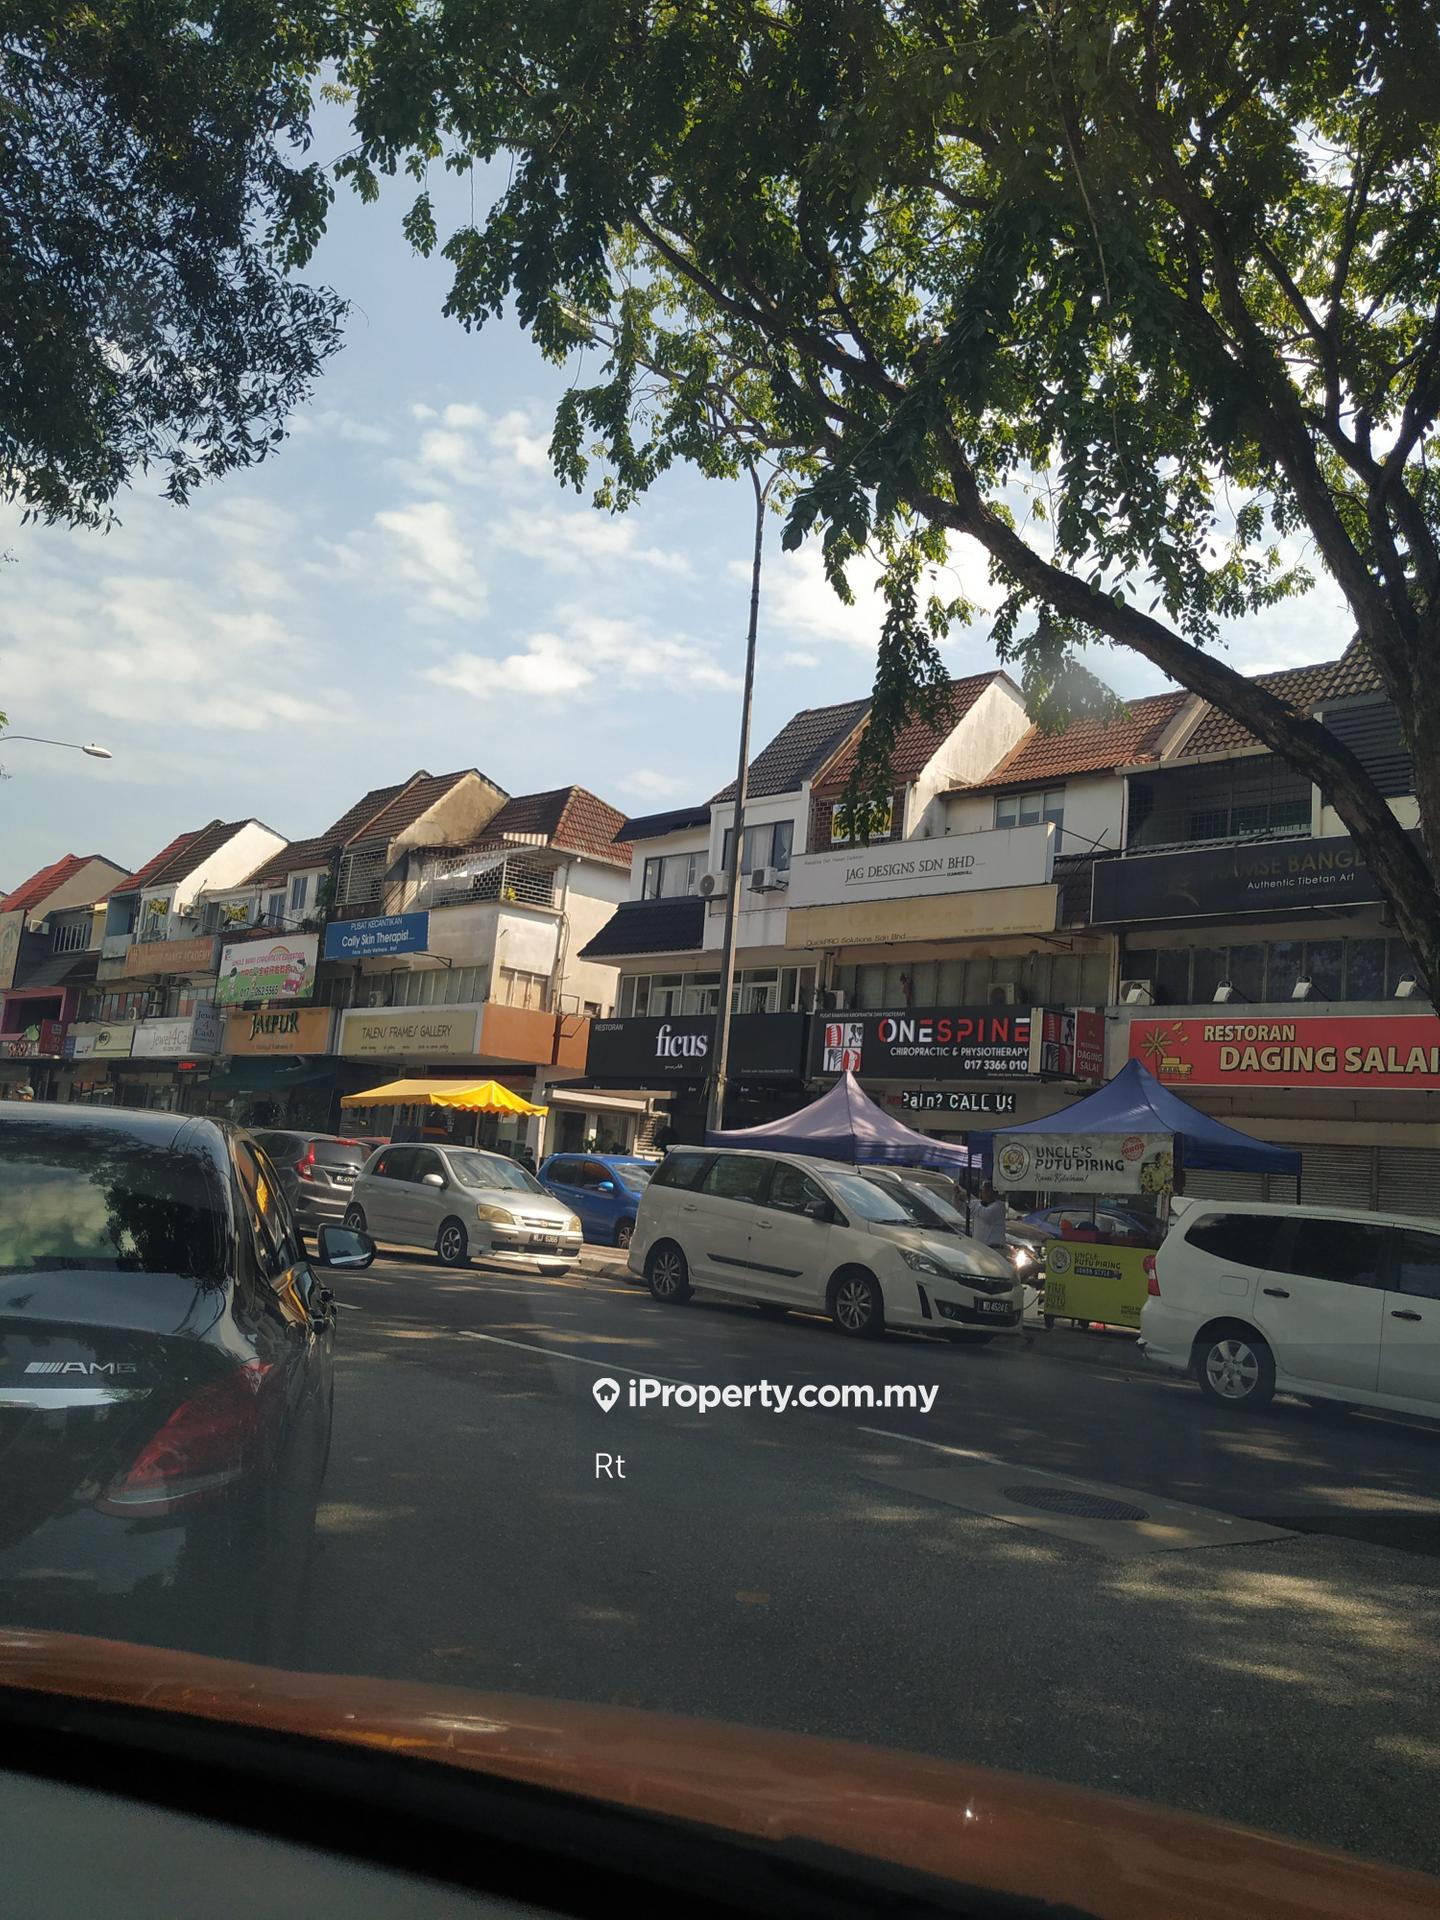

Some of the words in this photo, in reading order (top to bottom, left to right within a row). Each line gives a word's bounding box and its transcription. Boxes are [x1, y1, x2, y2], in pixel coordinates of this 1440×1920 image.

[845, 868, 864, 882] JAG
[868, 861, 915, 878] DESIGNS
[918, 858, 943, 872] SDN
[947, 855, 975, 869] BHD
[1247, 877, 1295, 889] Authentic
[1298, 874, 1336, 886] Tibetan
[1339, 872, 1355, 882] Art
[350, 921, 367, 931] PUSAT
[368, 917, 403, 928] KECANTIKAN
[361, 932, 375, 946] Skin
[376, 930, 409, 944] Therapist
[248, 1009, 299, 1040] JAIPUR
[389, 1024, 418, 1038] FRAMES
[420, 1024, 453, 1037] GALLERY
[594, 1023, 624, 1031] RESTORAN
[878, 1018, 1031, 1043] ONESPINE
[655, 1024, 708, 1057] ficus
[1204, 1025, 1296, 1042] RESTORAN
[890, 1047, 950, 1057] CHIROPRACTIC
[952, 1047, 958, 1057] &
[961, 1046, 1029, 1057] PHYSIOTHERAPY
[1076, 1049, 1103, 1062] DAGING
[964, 1060, 981, 1070] 017
[984, 1060, 1007, 1070] 3366
[1009, 1060, 1028, 1071] 010
[1080, 1061, 1099, 1072] SALAI
[1220, 1047, 1337, 1072] DAGING
[1344, 1047, 1440, 1073] SALAI
[949, 1093, 990, 1111] CALL
[1036, 1146, 1092, 1158] UNCLE'S
[1035, 1159, 1072, 1171] PUTU
[1076, 1159, 1125, 1172] PIRING
[1074, 1257, 1094, 1267] PUTU
[1095, 1260, 1121, 1270] PIRING
[62, 1362, 137, 1374] AMG
